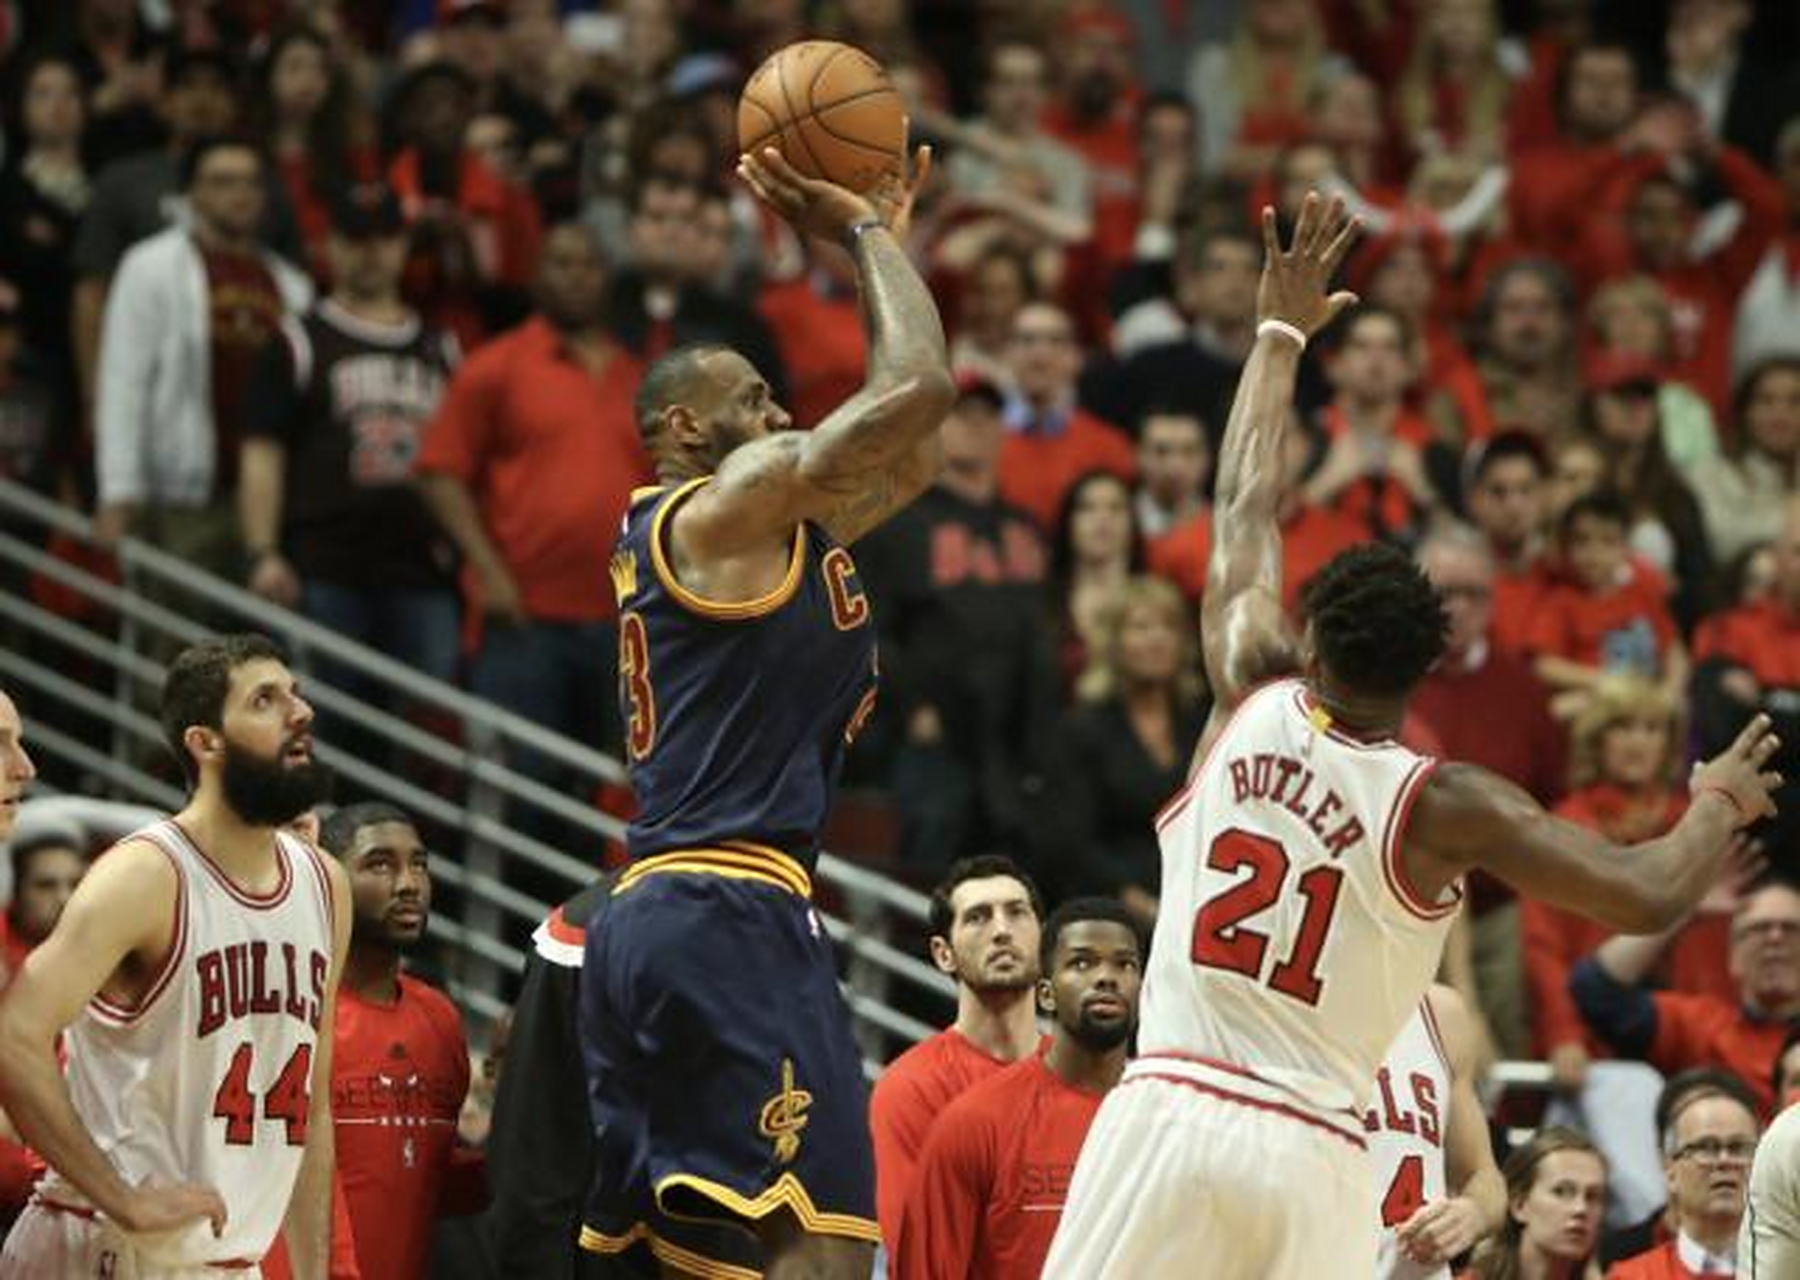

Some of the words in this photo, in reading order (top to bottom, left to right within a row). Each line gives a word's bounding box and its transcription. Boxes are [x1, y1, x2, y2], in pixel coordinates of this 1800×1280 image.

[1229, 753, 1365, 859] BUTLER
[1190, 826, 1344, 1007] 21
[196, 941, 327, 1039] BULLS
[213, 1042, 312, 1147] 44
[1381, 1155, 1428, 1227] 4
